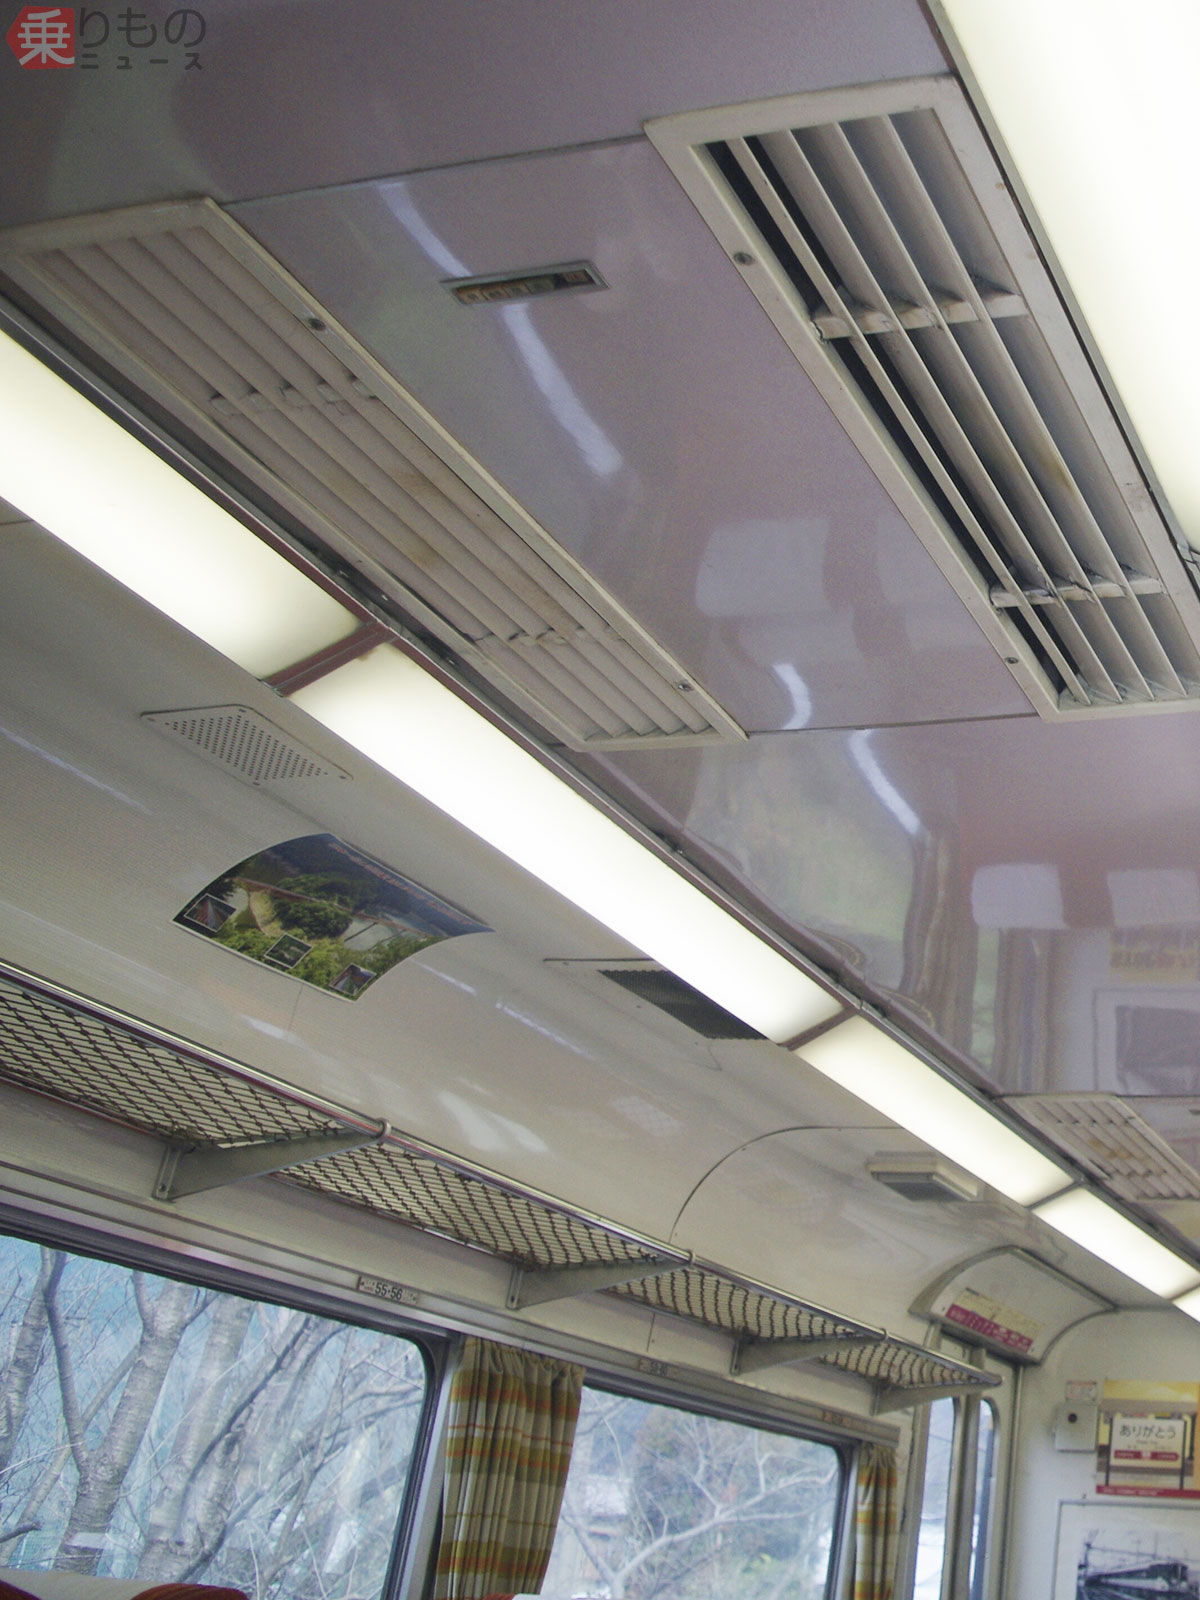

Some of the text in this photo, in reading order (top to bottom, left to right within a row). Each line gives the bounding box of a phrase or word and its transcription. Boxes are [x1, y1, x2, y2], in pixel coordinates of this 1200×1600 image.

[1119, 1424, 1176, 1439] ありがとう
